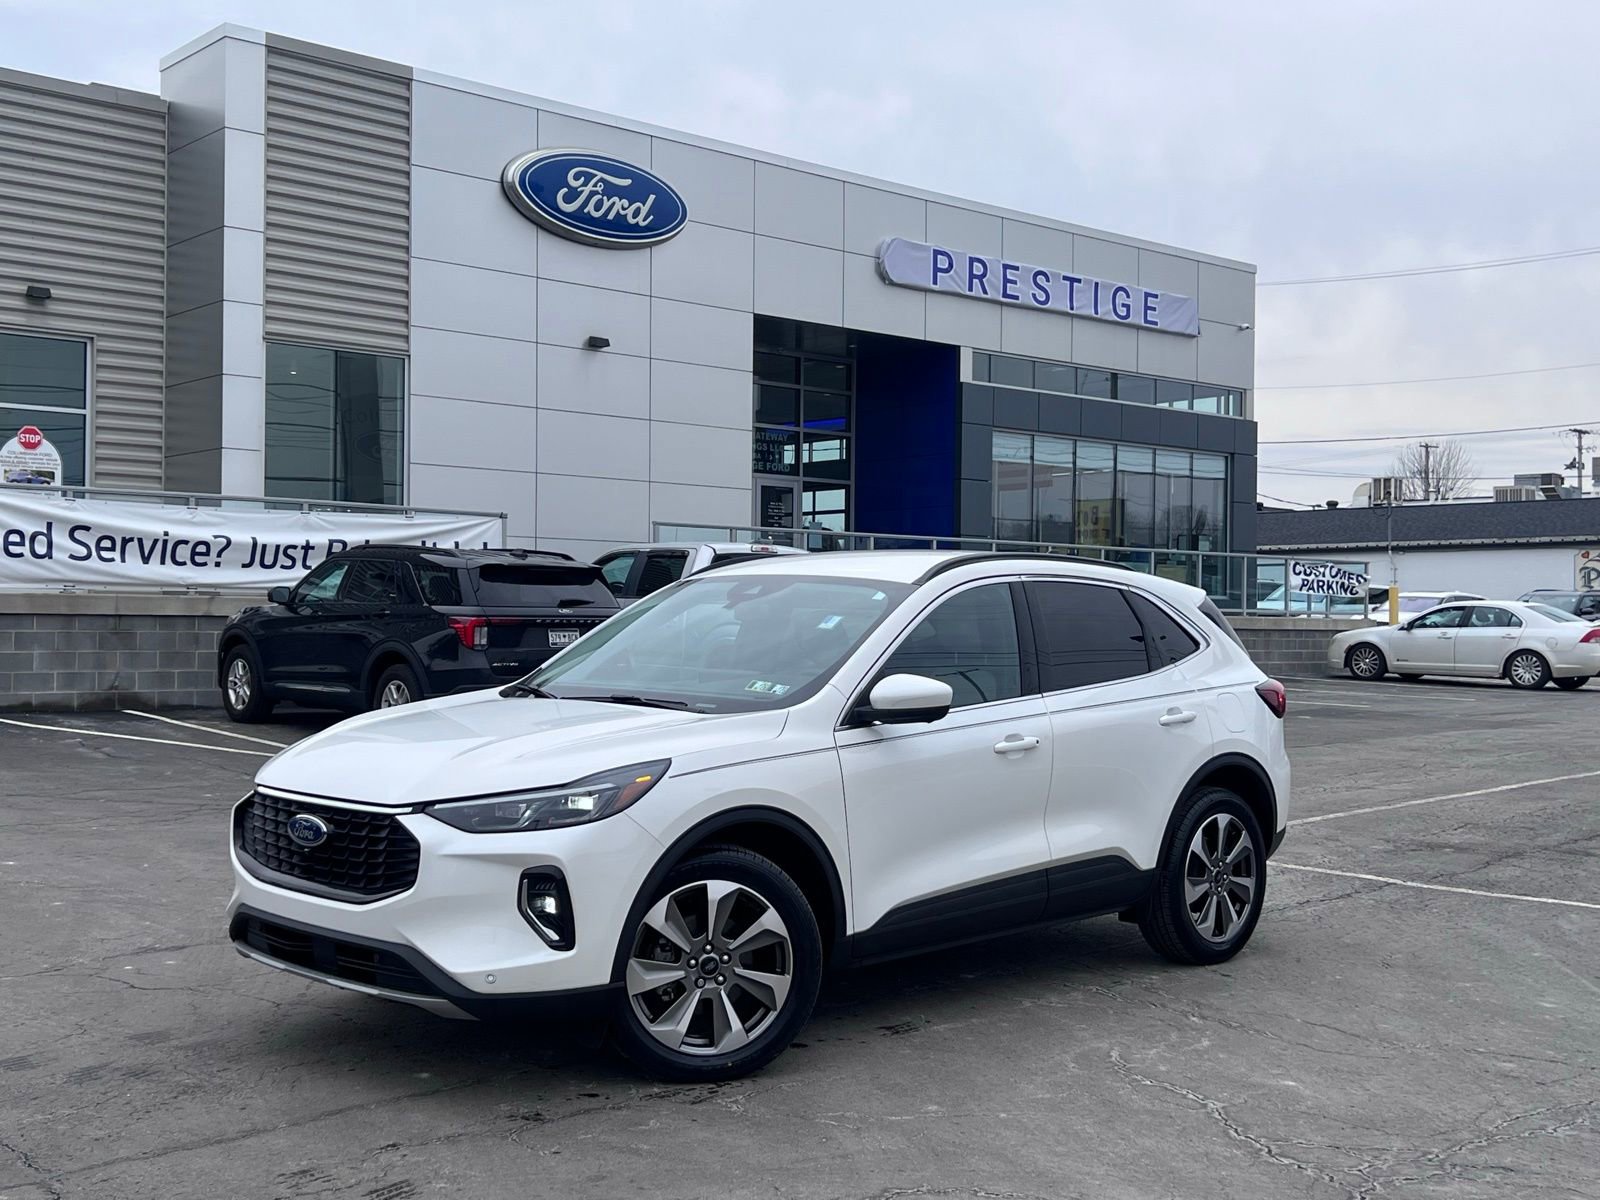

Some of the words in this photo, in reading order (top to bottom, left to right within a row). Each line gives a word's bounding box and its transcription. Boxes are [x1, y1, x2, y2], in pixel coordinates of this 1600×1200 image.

[556, 166, 656, 226] Ford
[931, 248, 1160, 327] PRESTIGE
[20, 433, 41, 443] STOP
[68, 524, 232, 568] Service?
[241, 536, 315, 570] Just
[1299, 579, 1359, 595] PARKING
